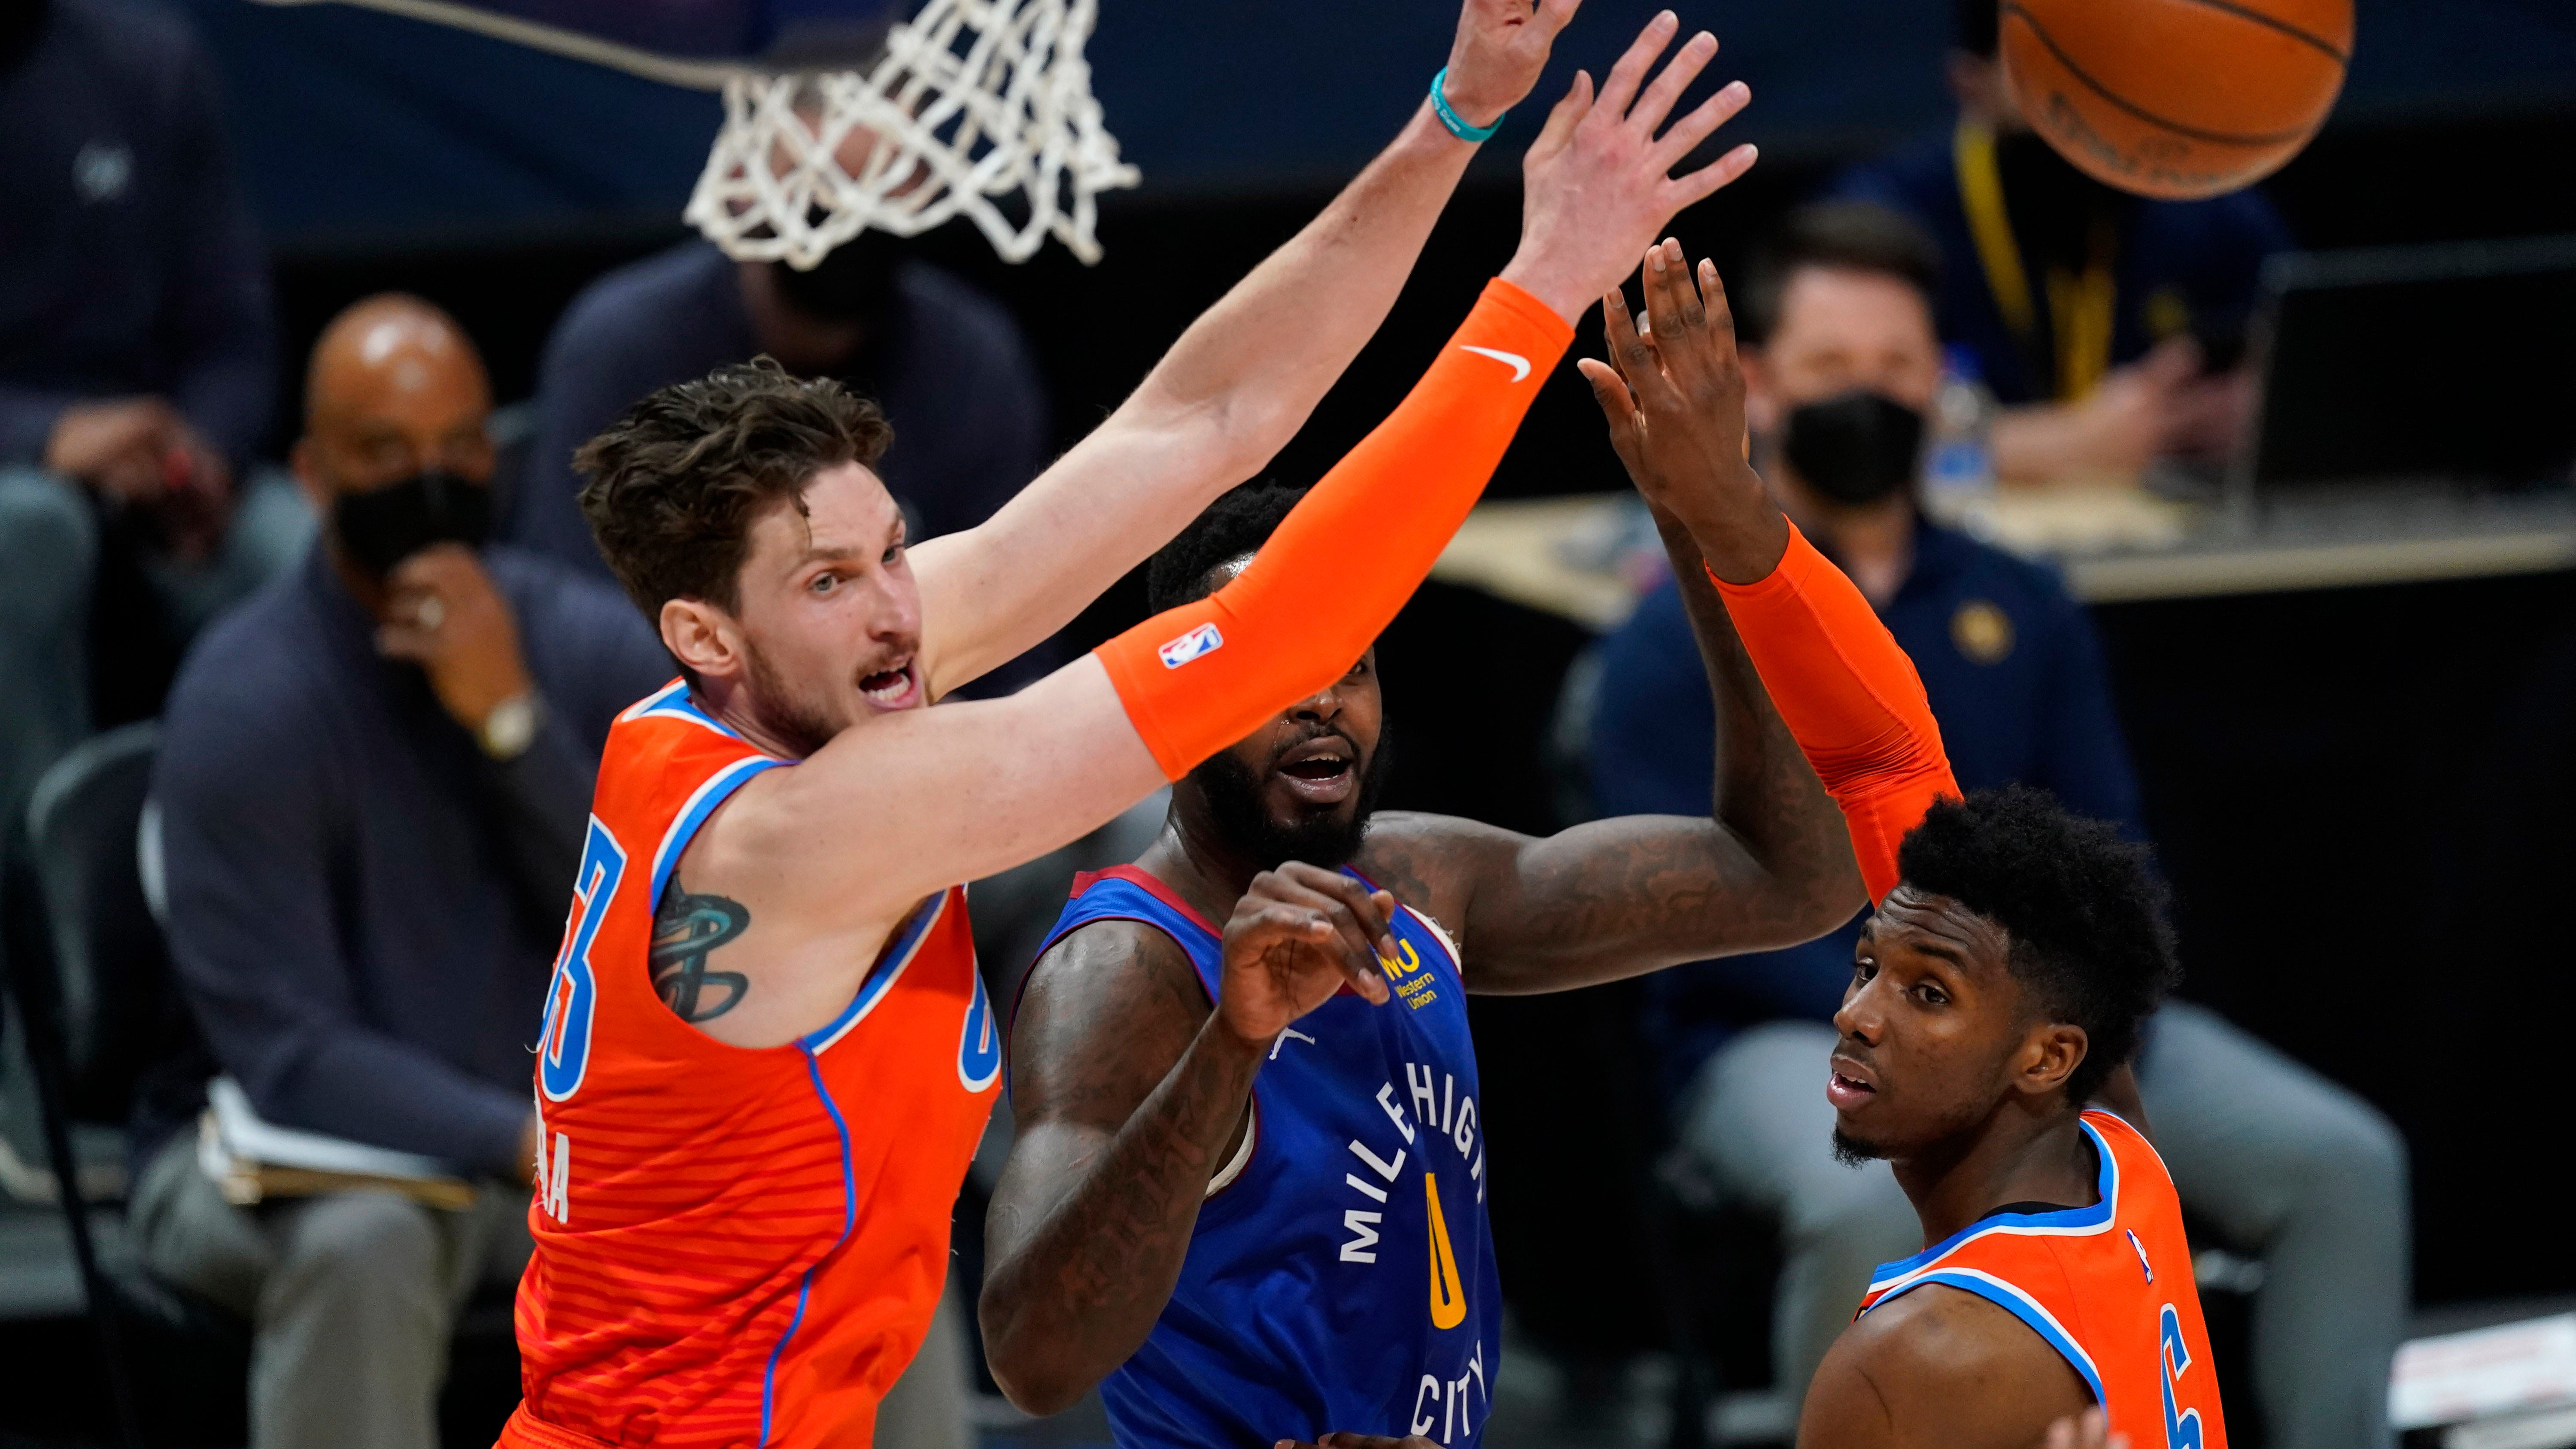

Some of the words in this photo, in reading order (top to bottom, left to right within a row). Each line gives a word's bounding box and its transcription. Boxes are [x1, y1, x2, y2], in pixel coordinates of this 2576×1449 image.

[1395, 972, 1435, 998] Western
[1407, 990, 1437, 1010] Union
[1340, 1081, 1415, 1264] MILE
[1425, 1172, 1467, 1330] 0
[1410, 1339, 1486, 1444] CITY
